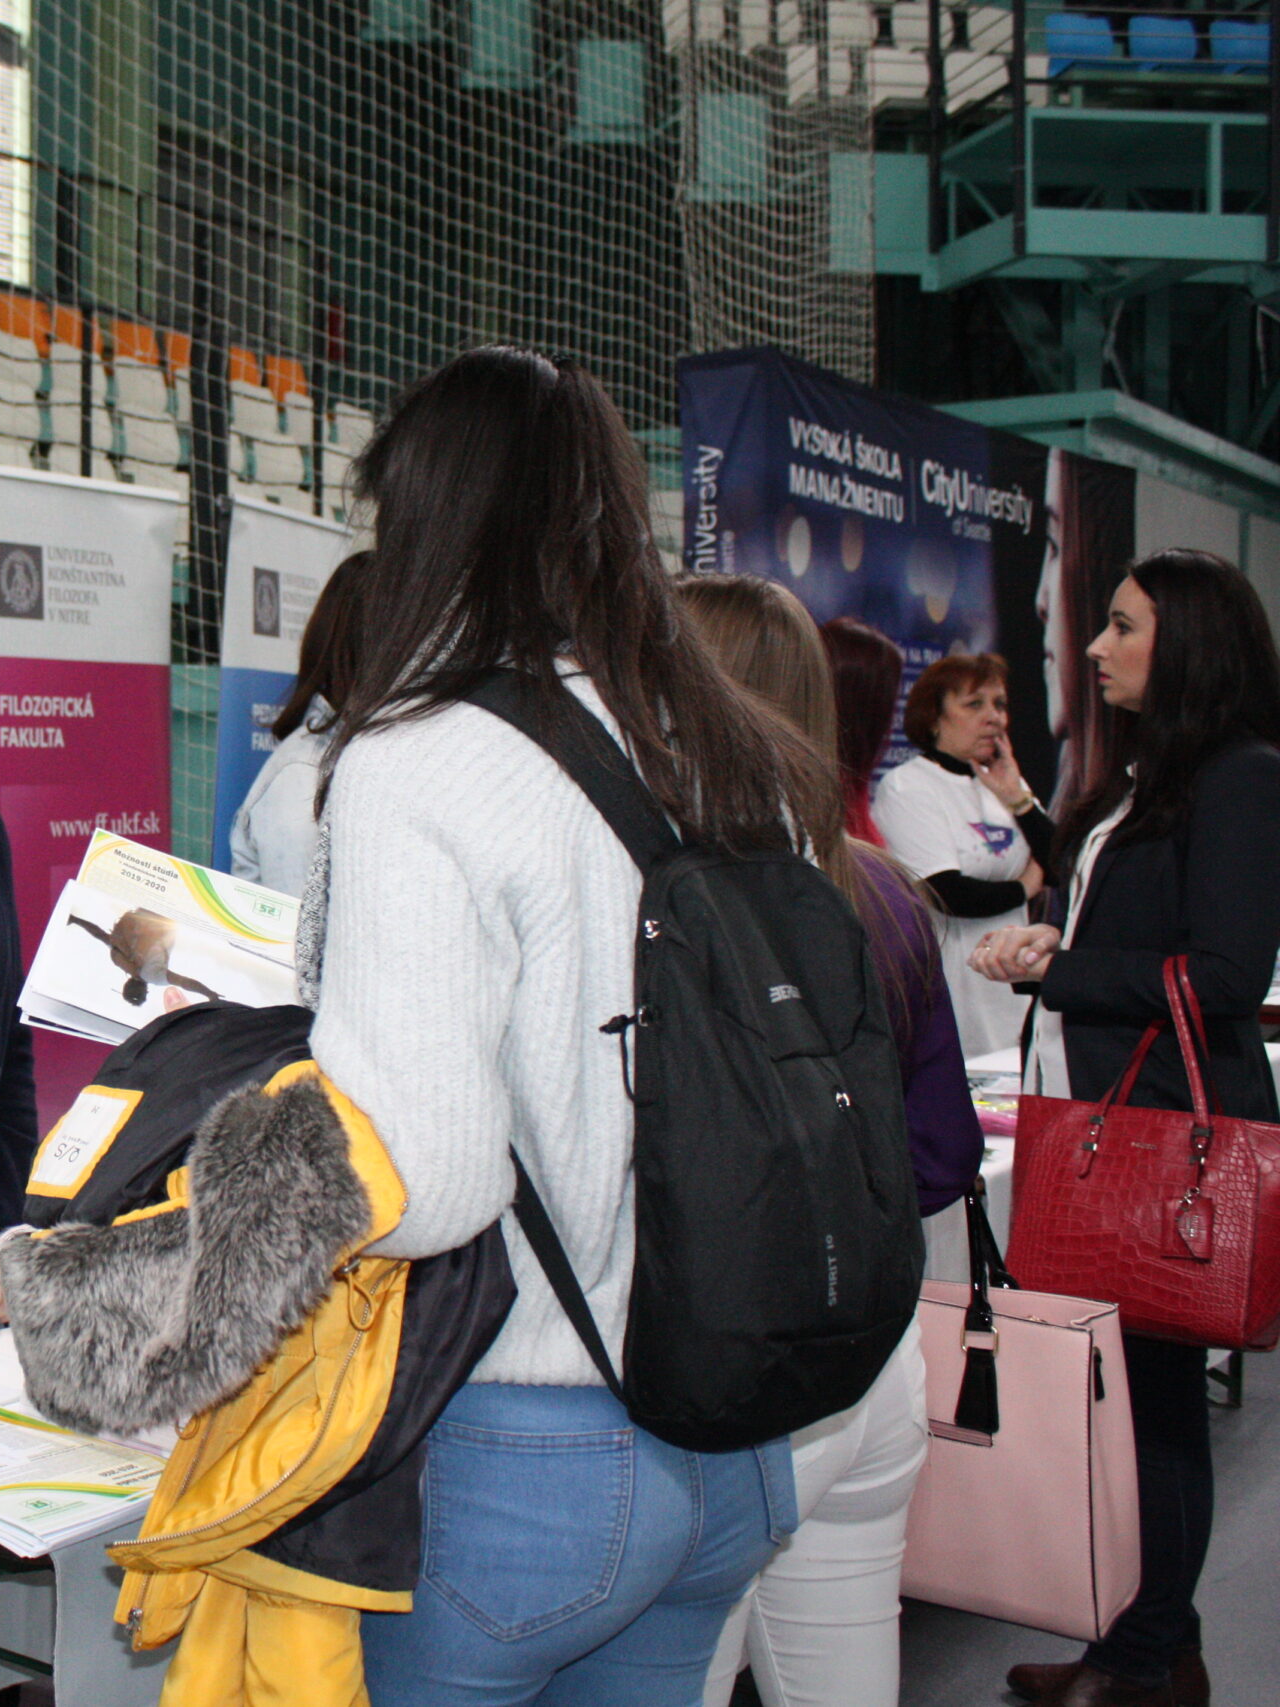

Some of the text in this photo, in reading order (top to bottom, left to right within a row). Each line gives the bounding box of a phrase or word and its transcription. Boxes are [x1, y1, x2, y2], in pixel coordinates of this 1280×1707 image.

[855, 433, 903, 482] ŠKOLA
[789, 463, 904, 523] MANAŽMENTU
[687, 445, 724, 575] niversity
[47, 546, 114, 567] UNIVERZITA
[48, 587, 100, 606] FILOZOFA
[48, 608, 90, 625] V NITRE
[0, 726, 65, 748] FAKULTA
[49, 811, 161, 838] www.ffukf.sk
[827, 1255, 838, 1308] SPIRIT
